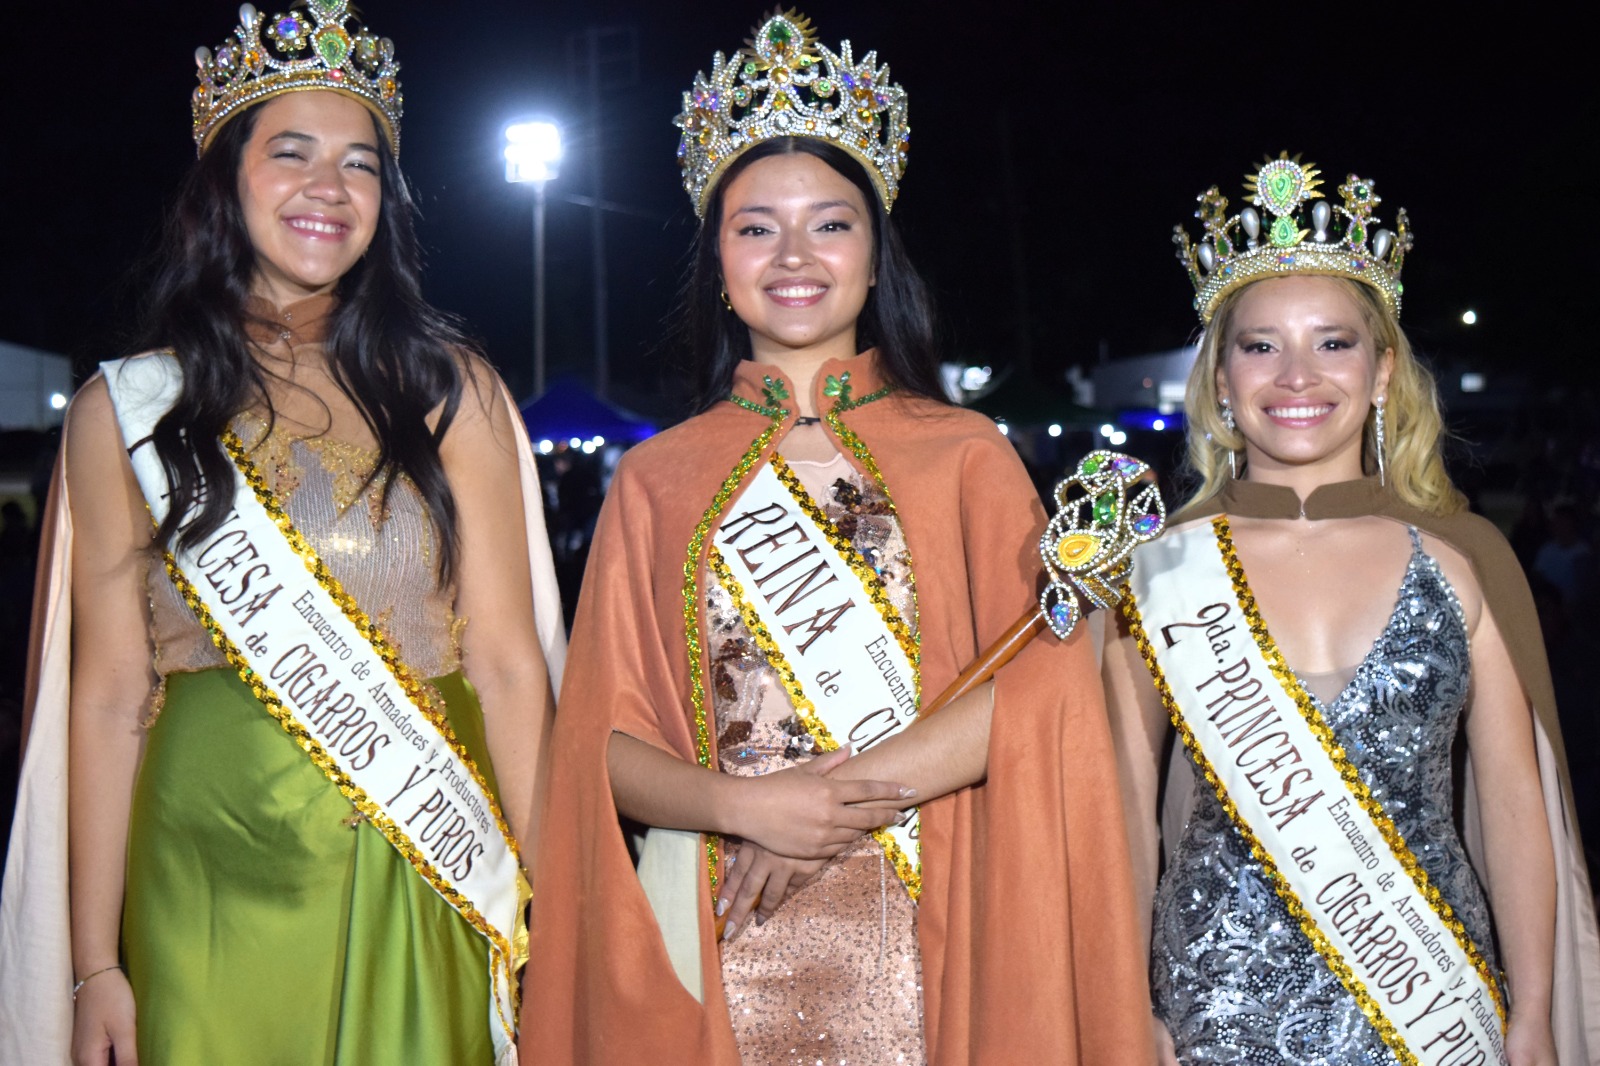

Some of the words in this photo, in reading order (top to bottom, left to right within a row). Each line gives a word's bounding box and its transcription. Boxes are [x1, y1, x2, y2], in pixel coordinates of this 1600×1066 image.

[245, 632, 269, 658] de
[718, 502, 857, 657] REINA
[816, 668, 840, 698] de
[1160, 602, 1237, 664] 2da.
[269, 643, 392, 771] CIGARROS
[291, 590, 353, 661] Encuentro
[351, 660, 371, 681] de
[368, 681, 429, 751] Armadores
[425, 748, 440, 765] y
[439, 758, 492, 835] Productores
[864, 634, 918, 717] Encuentro
[385, 764, 437, 808] Y
[1195, 657, 1325, 833] PRINCESA
[404, 788, 485, 882] PUROS
[1290, 845, 1318, 874] de
[1315, 872, 1433, 1005] CIGARROS
[1327, 796, 1380, 870] Encuentro
[1376, 871, 1396, 892] de
[1391, 894, 1455, 974] Armadores
[1449, 976, 1466, 991] y
[1404, 990, 1463, 1029] Y
